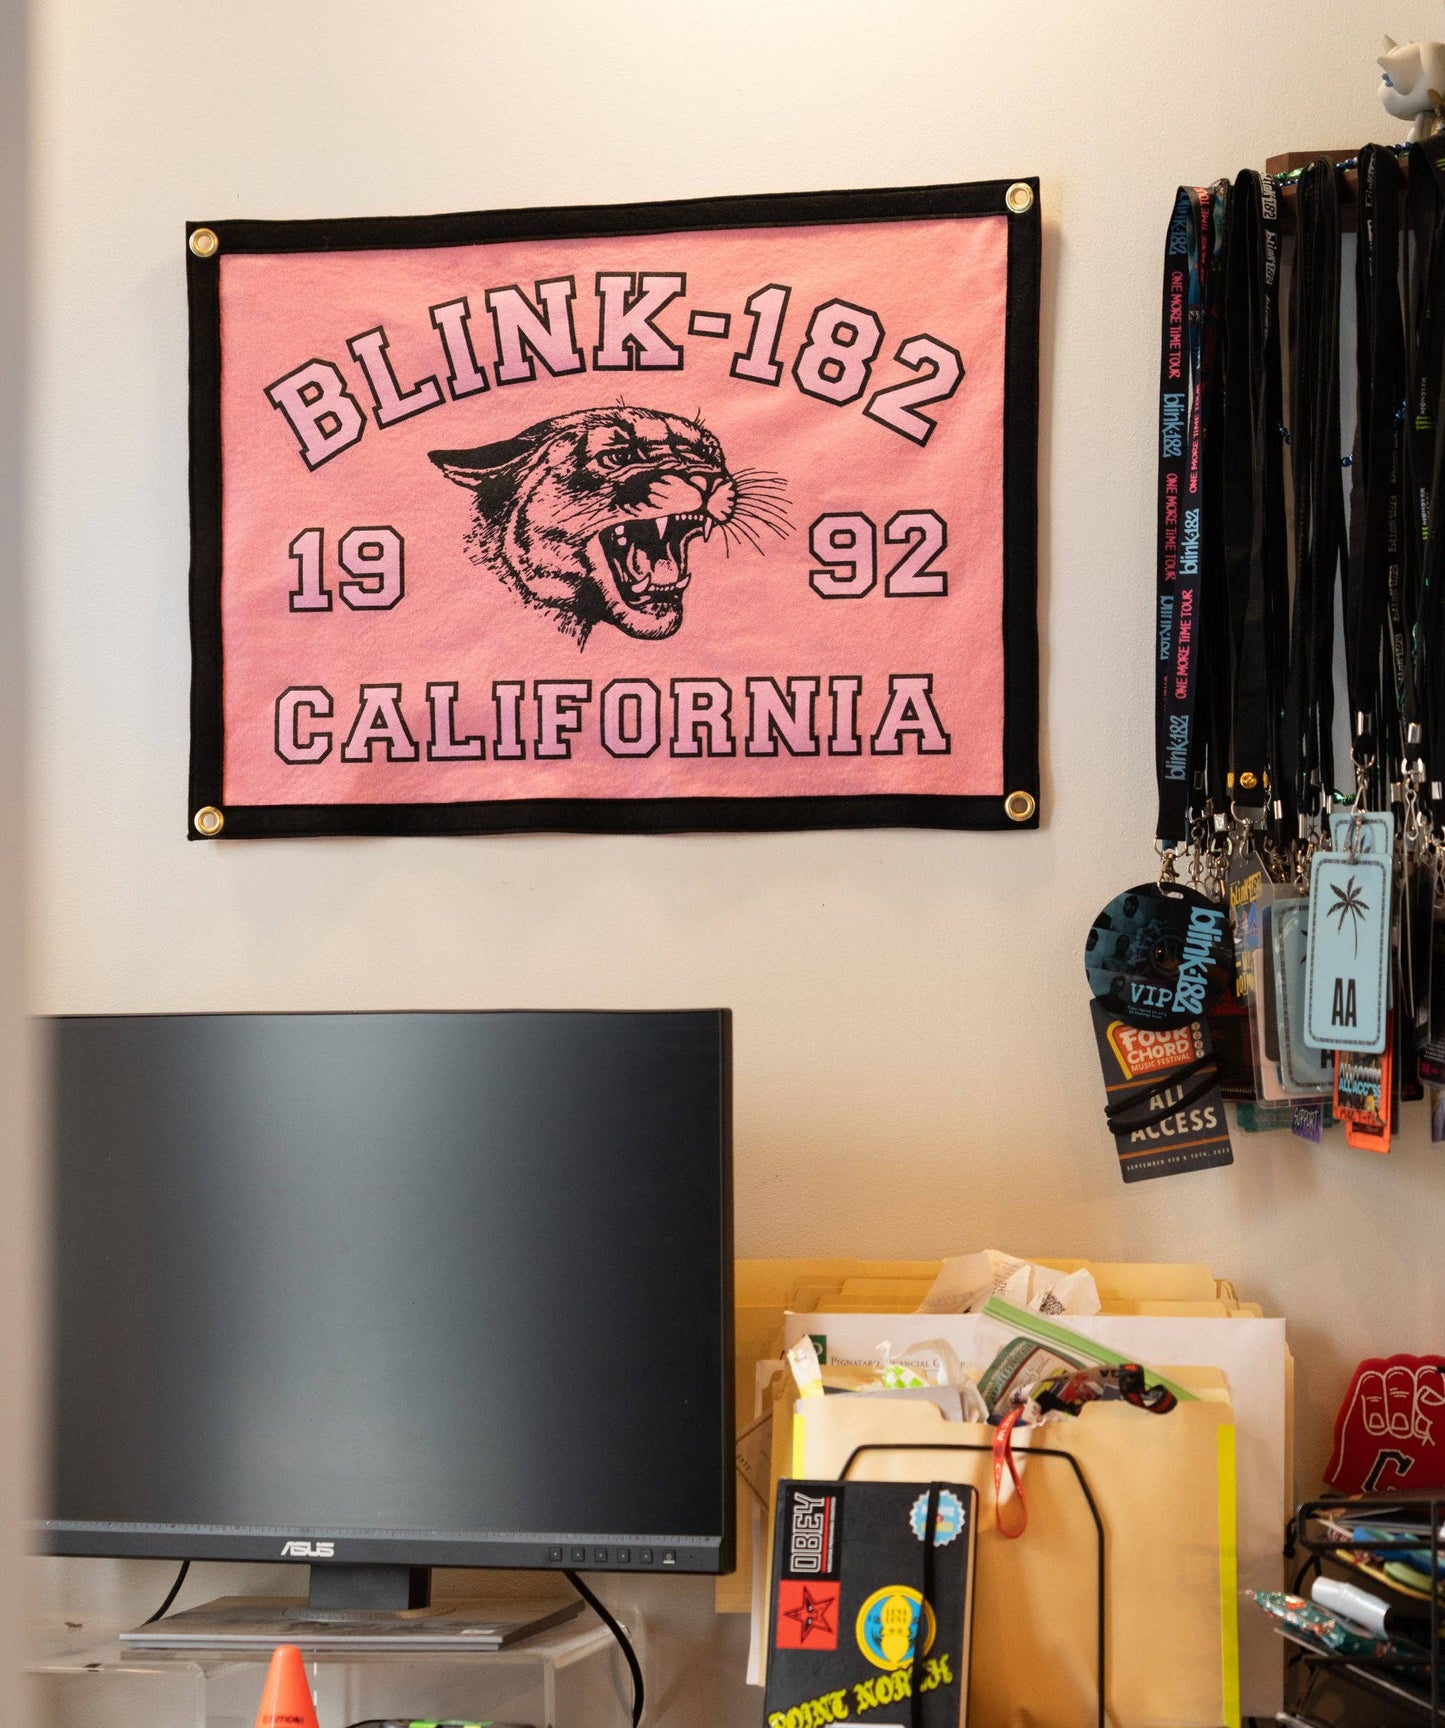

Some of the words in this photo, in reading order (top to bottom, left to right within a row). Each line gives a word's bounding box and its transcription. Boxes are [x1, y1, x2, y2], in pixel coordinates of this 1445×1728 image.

[1194, 187, 1210, 206] TOU
[1170, 271, 1184, 293] ONE
[1169, 293, 1183, 324] MORE
[1169, 326, 1182, 350] TIME
[263, 271, 966, 471] BLINK-182
[1167, 351, 1182, 379] TOUR
[1191, 440, 1200, 471] MORE
[1165, 472, 1178, 494] ONE
[1189, 471, 1198, 494] ONE
[1165, 495, 1178, 526] MORE
[1164, 527, 1177, 551] TIME
[288, 524, 405, 613] 19
[808, 508, 949, 600] 92
[1164, 554, 1177, 581] TOUR
[1181, 588, 1194, 616] TOUR
[1178, 619, 1192, 644] TIME
[1176, 645, 1190, 676] MORE
[1175, 677, 1188, 700] ONE
[274, 673, 952, 766] CALIFORNIA
[1131, 982, 1173, 1008] VIP
[1331, 977, 1357, 1027] AA
[1119, 1026, 1189, 1051] FOUR
[1127, 1039, 1190, 1065] CHORD
[1131, 1061, 1156, 1073] MUSIC
[1157, 1053, 1191, 1066] FESTIVAL
[1339, 1078, 1352, 1093] ALL
[1130, 1107, 1217, 1143] ACCESS
[1126, 1159, 1164, 1171] SEPTEMBER
[790, 1492, 825, 1573] OBEY
[281, 1541, 335, 1557] ASUS
[768, 1688, 849, 1728] POINT
[853, 1654, 953, 1715] NORH
